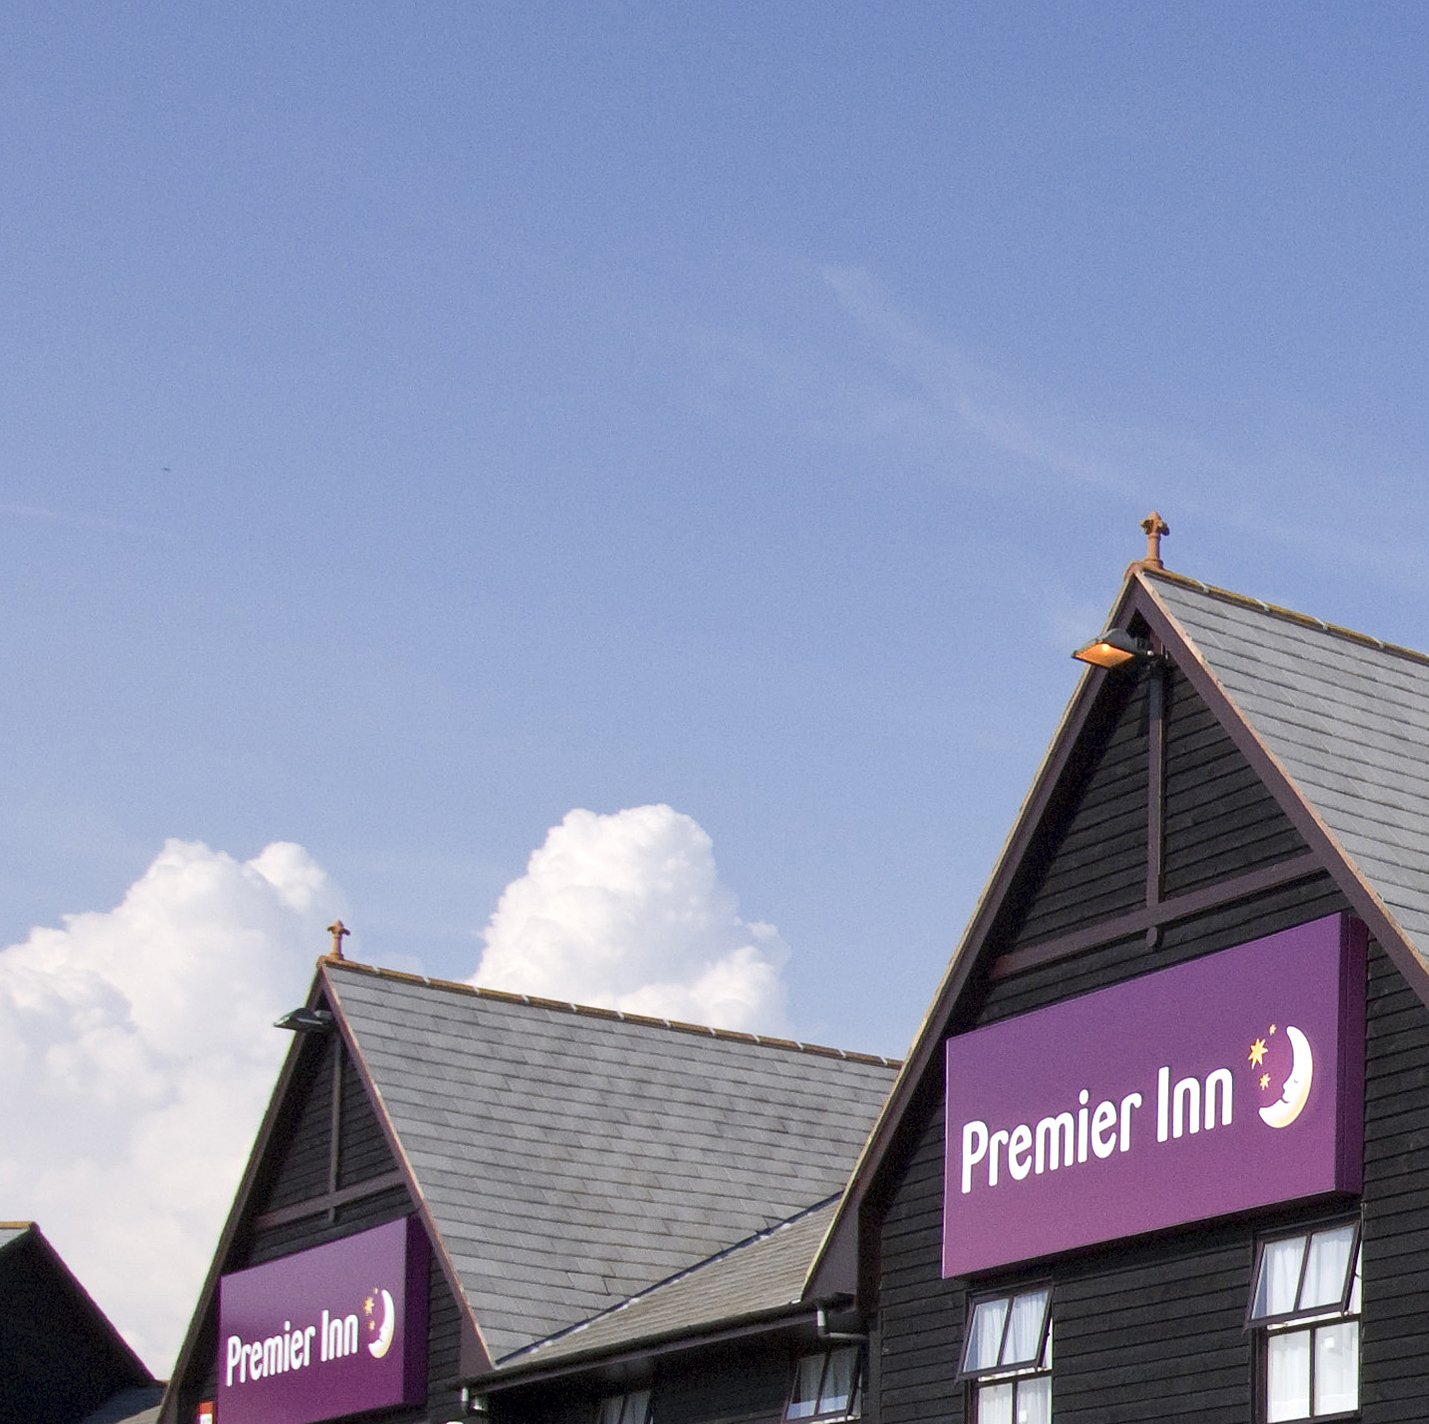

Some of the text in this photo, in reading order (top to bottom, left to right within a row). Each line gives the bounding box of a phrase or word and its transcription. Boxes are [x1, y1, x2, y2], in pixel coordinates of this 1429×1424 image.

[961, 1066, 1233, 1194] Premier Inn
[226, 1309, 359, 1387] Premier Inn
